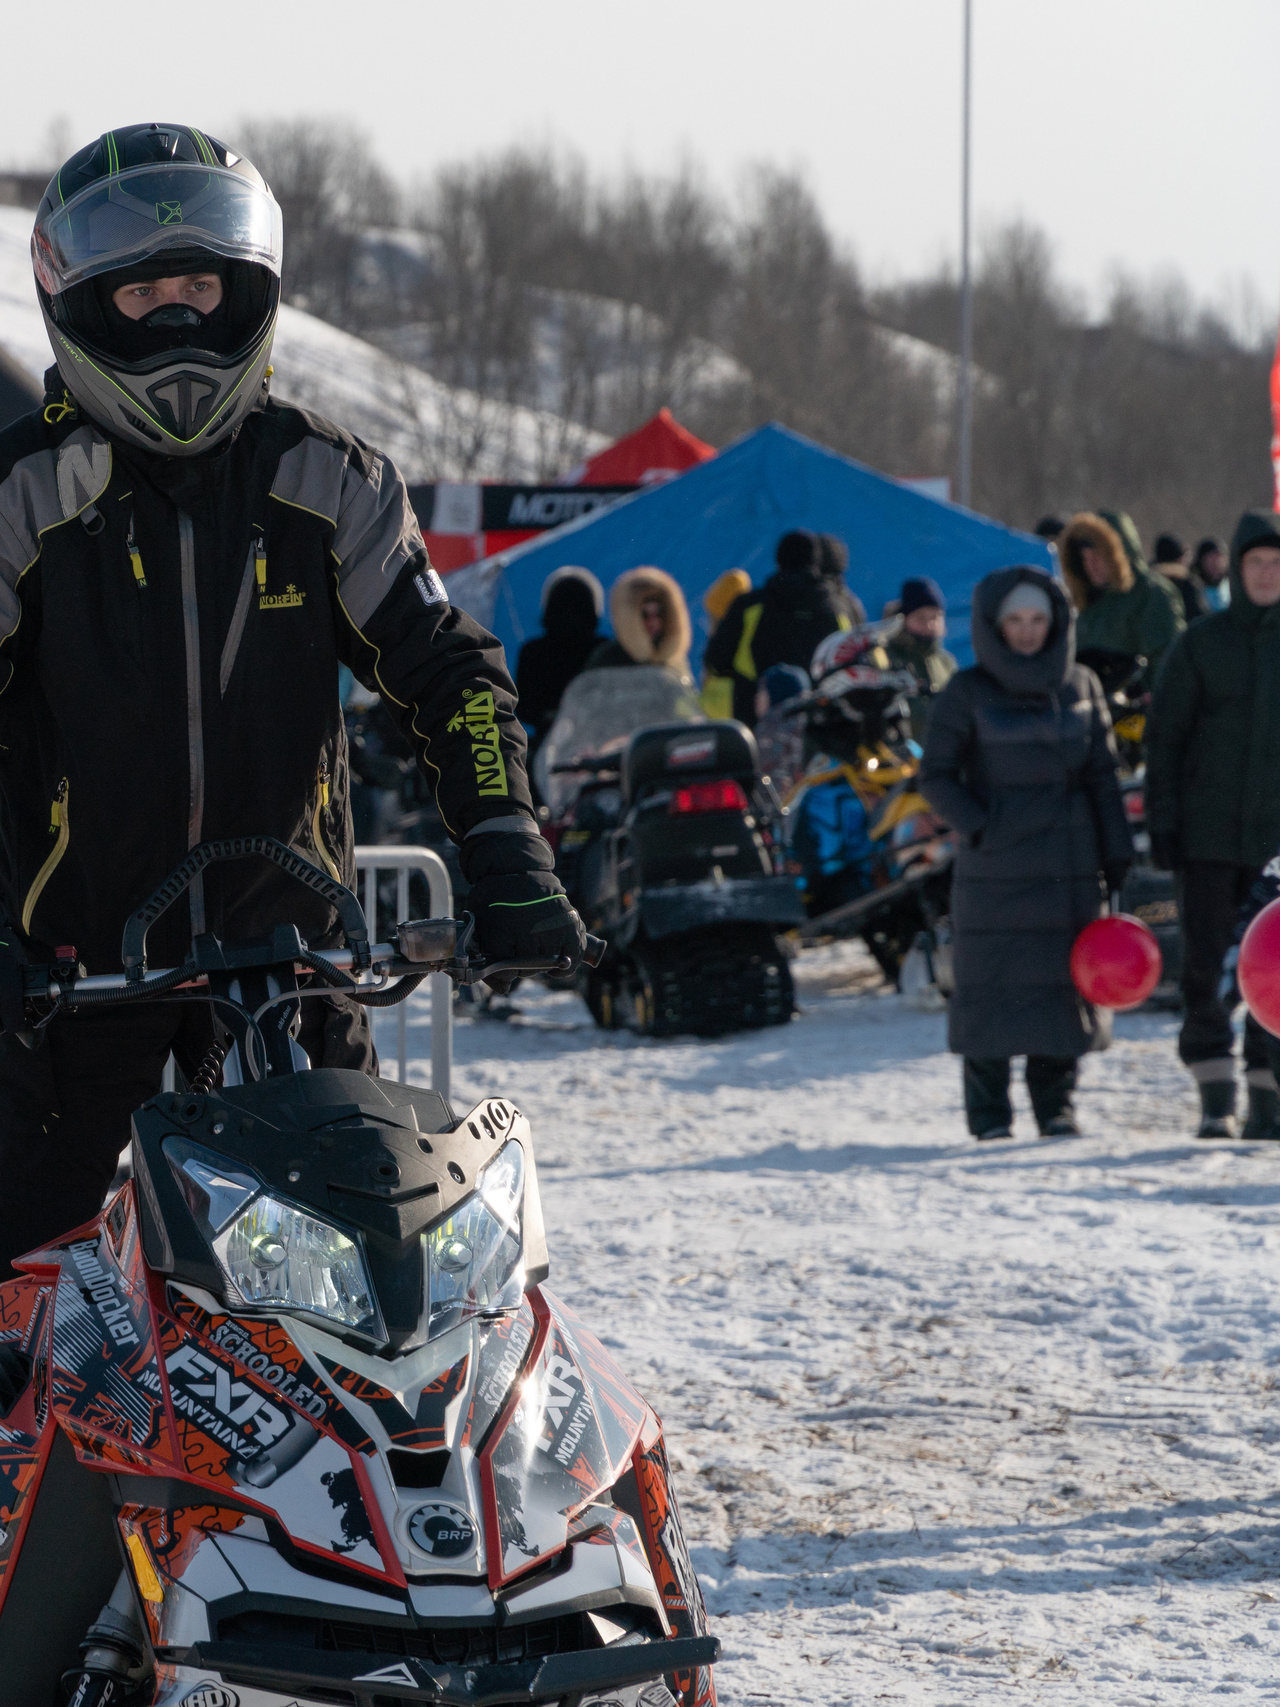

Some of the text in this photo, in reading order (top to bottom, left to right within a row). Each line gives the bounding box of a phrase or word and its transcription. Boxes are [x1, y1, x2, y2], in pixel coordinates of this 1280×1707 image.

[57, 442, 111, 519] N
[508, 492, 623, 525] MOTO
[259, 592, 303, 609] NORFIN
[152, 1344, 290, 1447] FXR
[209, 1325, 327, 1420] SCHOOLED
[484, 1321, 532, 1407] SCHOOLED
[136, 1369, 248, 1451] MOUNTAIN
[437, 1530, 472, 1541] BRP
